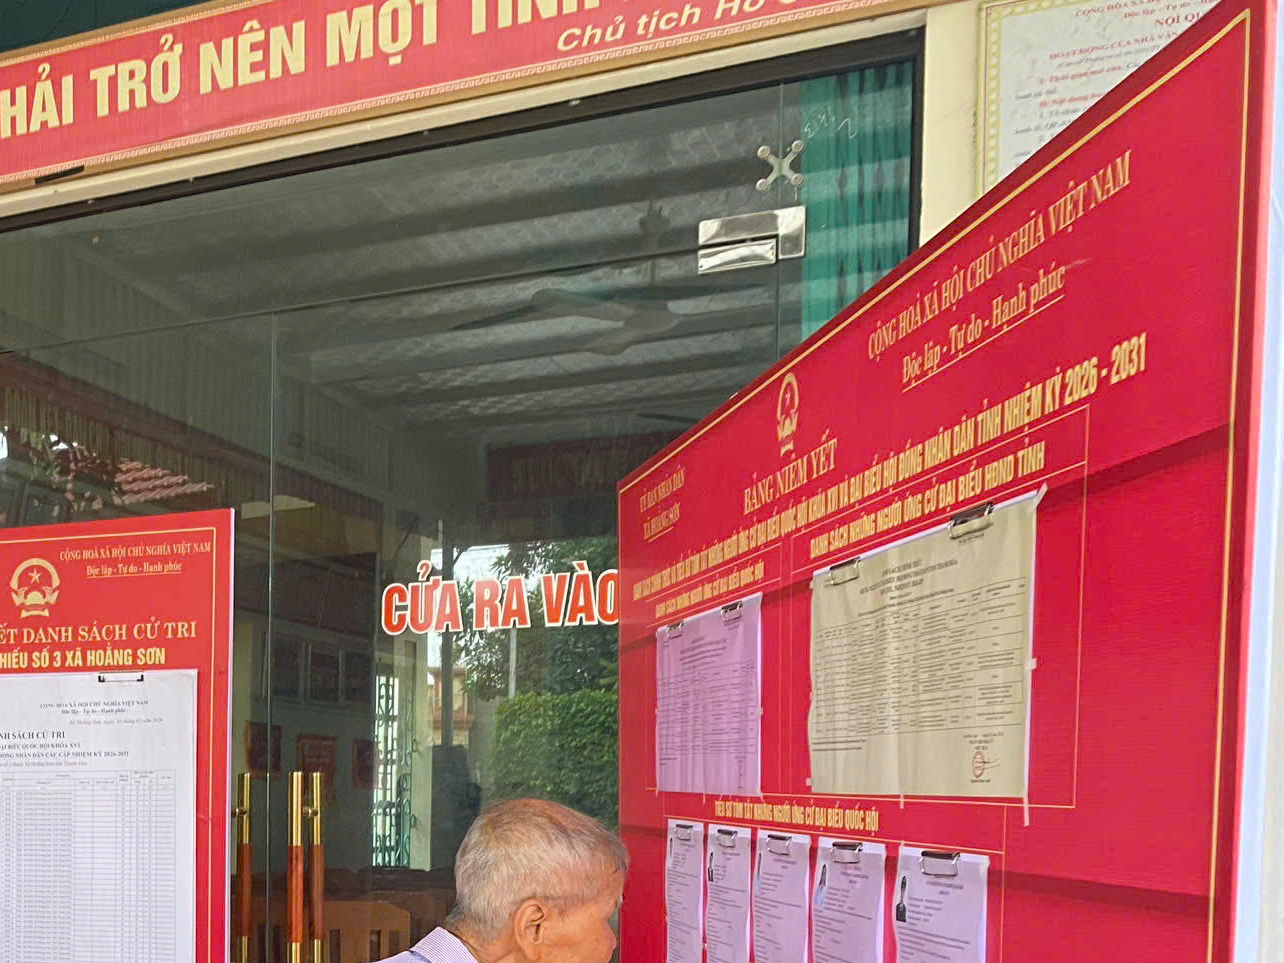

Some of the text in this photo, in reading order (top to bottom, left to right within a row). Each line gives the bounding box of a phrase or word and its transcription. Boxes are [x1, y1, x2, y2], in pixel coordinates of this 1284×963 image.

[557, 15, 625, 51] Chủ
[637, 3, 702, 39] tịch
[89, 34, 183, 118] TRỞ
[199, 20, 306, 95] NÊN
[1048, 179, 1088, 236] VIỆT
[1089, 149, 1132, 210] NAM
[949, 323, 966, 358] Tự
[967, 313, 982, 346] do
[991, 282, 1027, 332] Hạnh
[1028, 261, 1066, 313] phúc
[977, 398, 1003, 447] TỈNH
[1003, 382, 1043, 434] NHIỆM
[1044, 367, 1063, 415] KỲ
[1063, 356, 1099, 406] 2026
[1109, 331, 1147, 386] 2031
[59, 548, 81, 563] CỘNG
[112, 545, 126, 560] HỘI
[127, 542, 144, 557] CHỦ
[173, 541, 191, 557] VIỆT
[193, 542, 211, 553] NAM
[129, 563, 138, 574] do
[143, 562, 163, 575] Hạnh
[164, 560, 182, 574] phúc
[382, 560, 463, 635] CỬA
[473, 576, 531, 630] RA
[541, 560, 619, 627] VÀO
[23, 626, 73, 643] DANH
[78, 620, 127, 641] SÁCH
[133, 616, 160, 639] CỬ
[163, 621, 197, 638] TRI
[31, 646, 50, 668] SỐ
[53, 652, 61, 667] 3
[65, 647, 83, 668] XÃ
[87, 642, 132, 667] HOẰNG
[137, 646, 165, 665] SƠN
